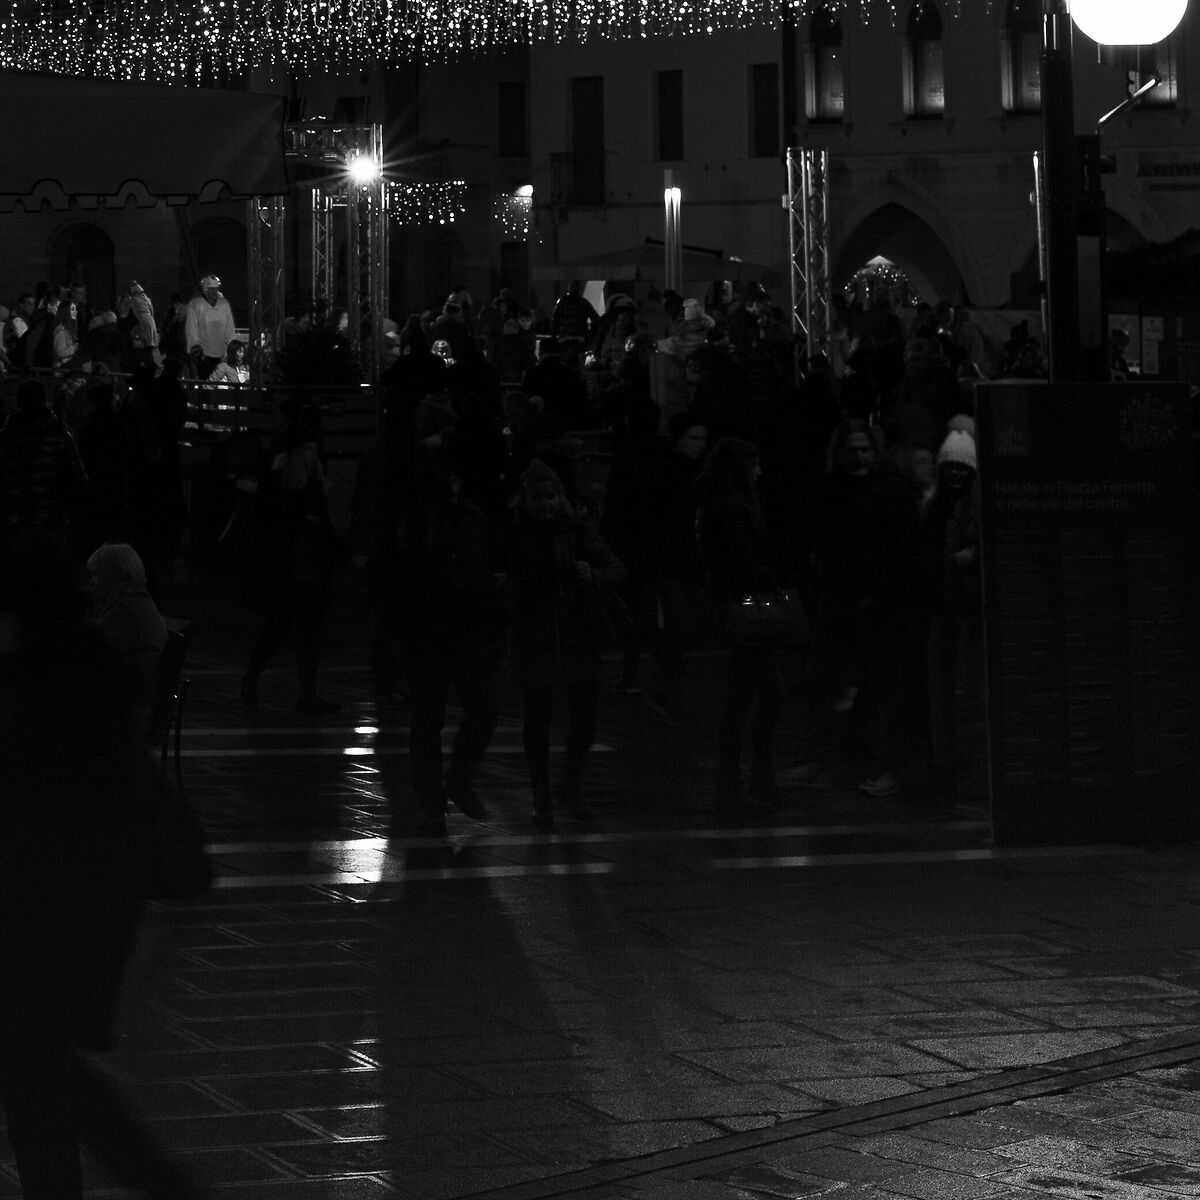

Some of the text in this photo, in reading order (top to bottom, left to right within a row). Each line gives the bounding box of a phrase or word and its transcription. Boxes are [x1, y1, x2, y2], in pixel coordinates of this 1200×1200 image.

[994, 479, 1156, 494] Natale in Piazza Ferretto
[1007, 497, 1039, 511] nelle
[1087, 497, 1130, 510] centro
